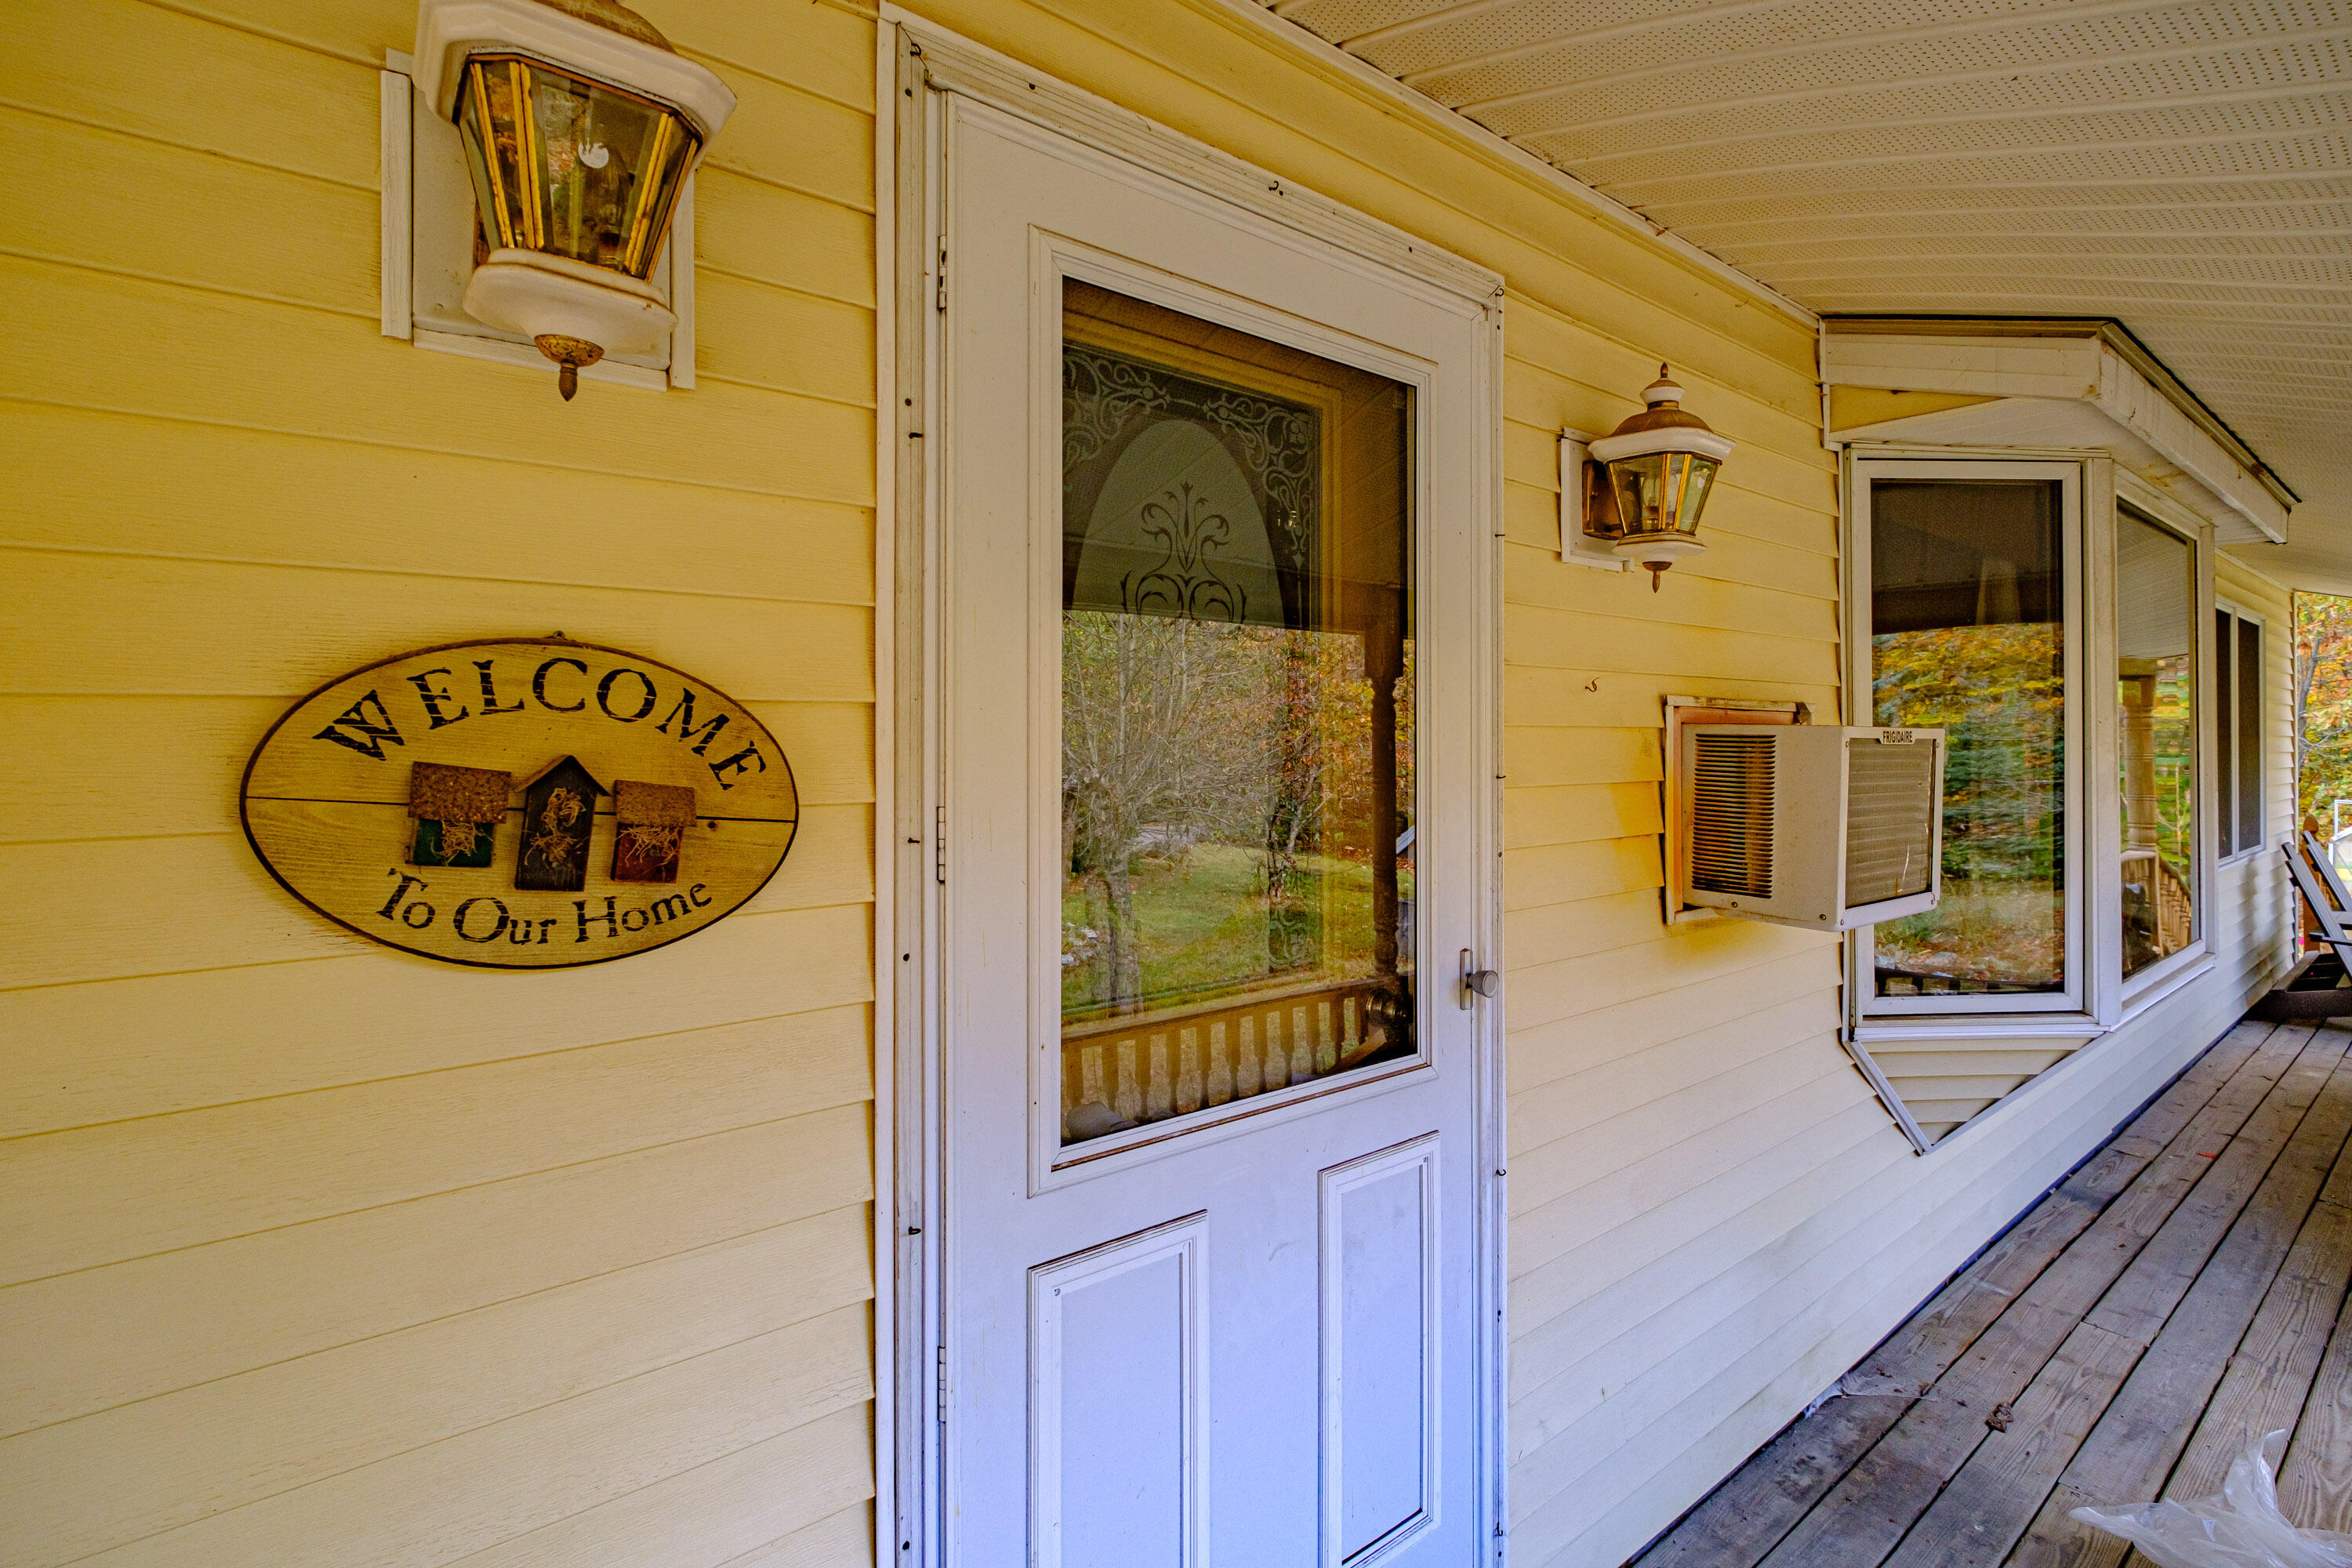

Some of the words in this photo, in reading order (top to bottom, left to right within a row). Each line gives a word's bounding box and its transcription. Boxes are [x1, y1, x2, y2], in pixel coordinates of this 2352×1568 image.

[312, 657, 766, 790] WELCOME
[1882, 731, 1913, 743] FRIGIDAIRE
[376, 867, 436, 929] To
[452, 897, 557, 945] Our
[572, 883, 713, 943] Home
